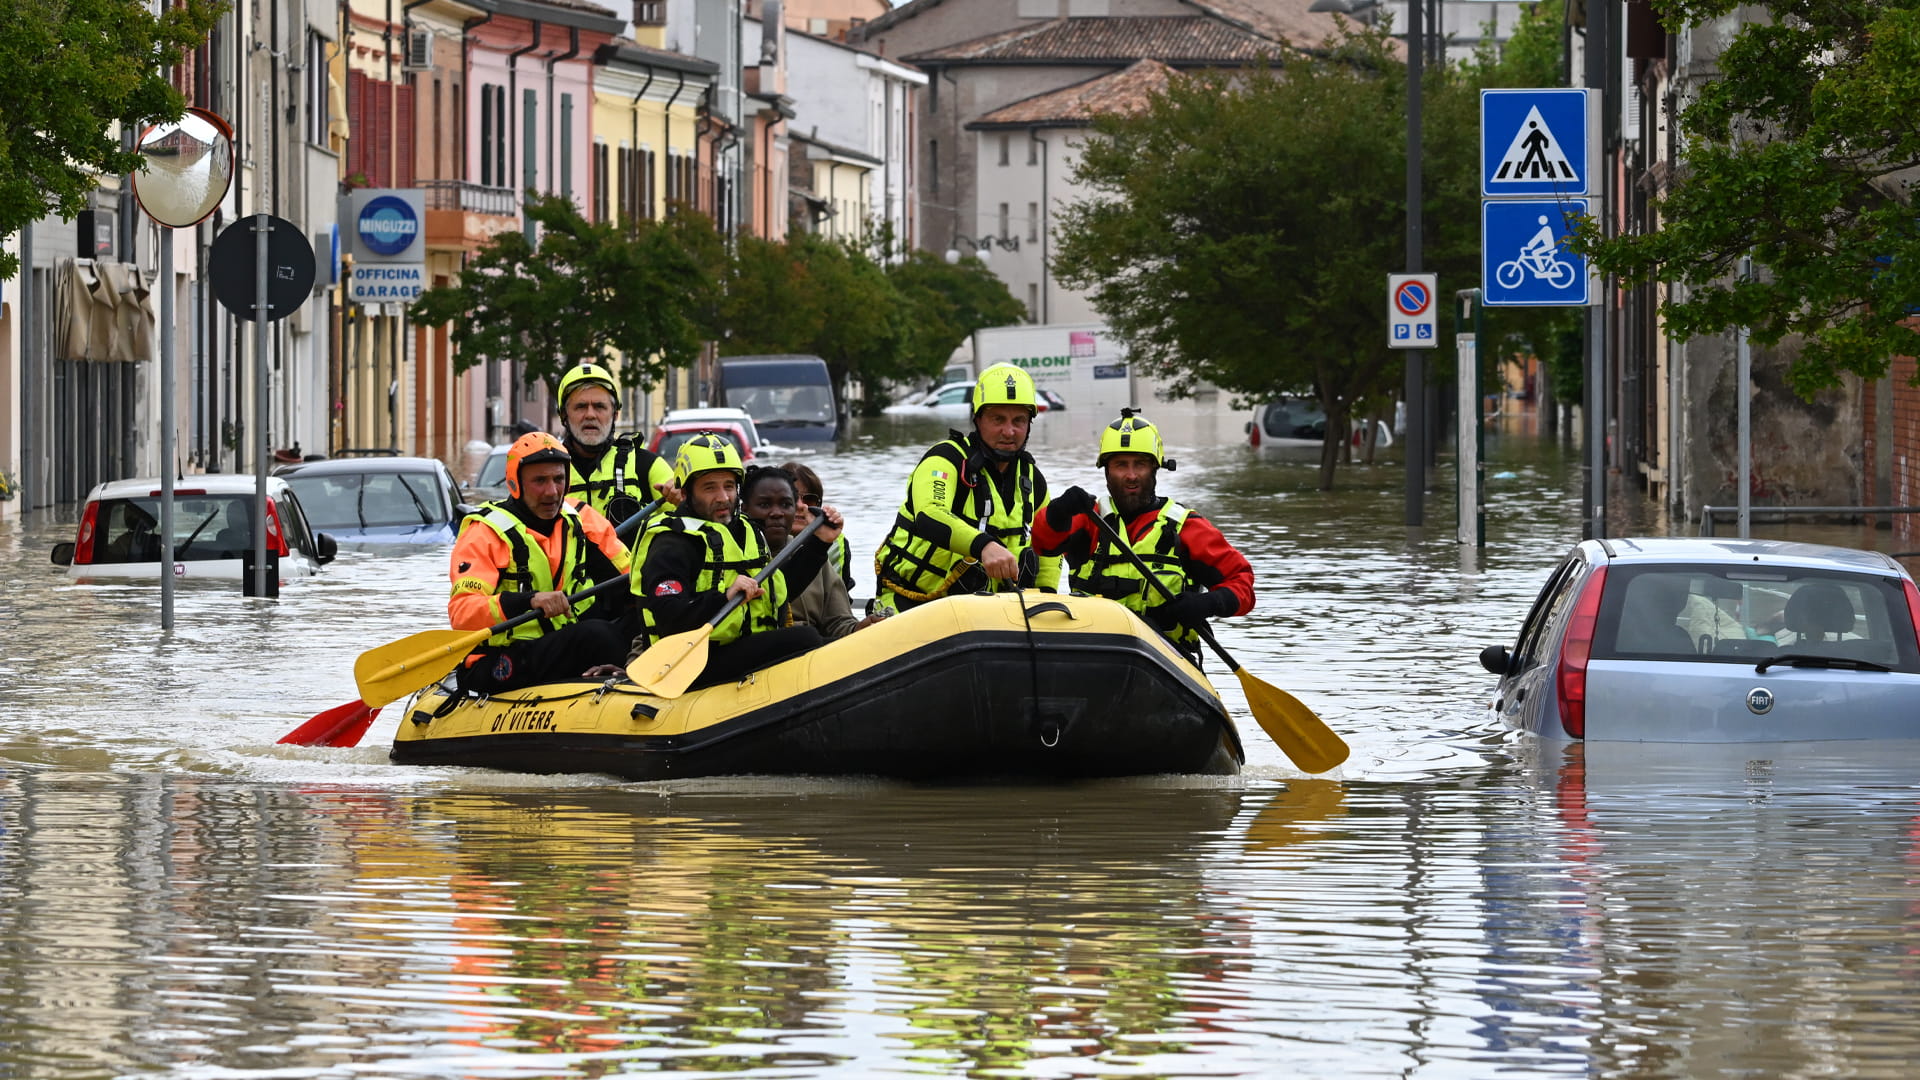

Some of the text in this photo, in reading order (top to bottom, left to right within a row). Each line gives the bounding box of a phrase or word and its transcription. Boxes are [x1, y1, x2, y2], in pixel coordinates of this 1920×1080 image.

[360, 219, 417, 233] MINGUZZI
[356, 269, 420, 280] OFFICINA
[356, 286, 421, 298] GARAGE
[1397, 326, 1407, 338] P
[1010, 356, 1071, 368] TARONI
[1751, 696, 1769, 705] FIAT
